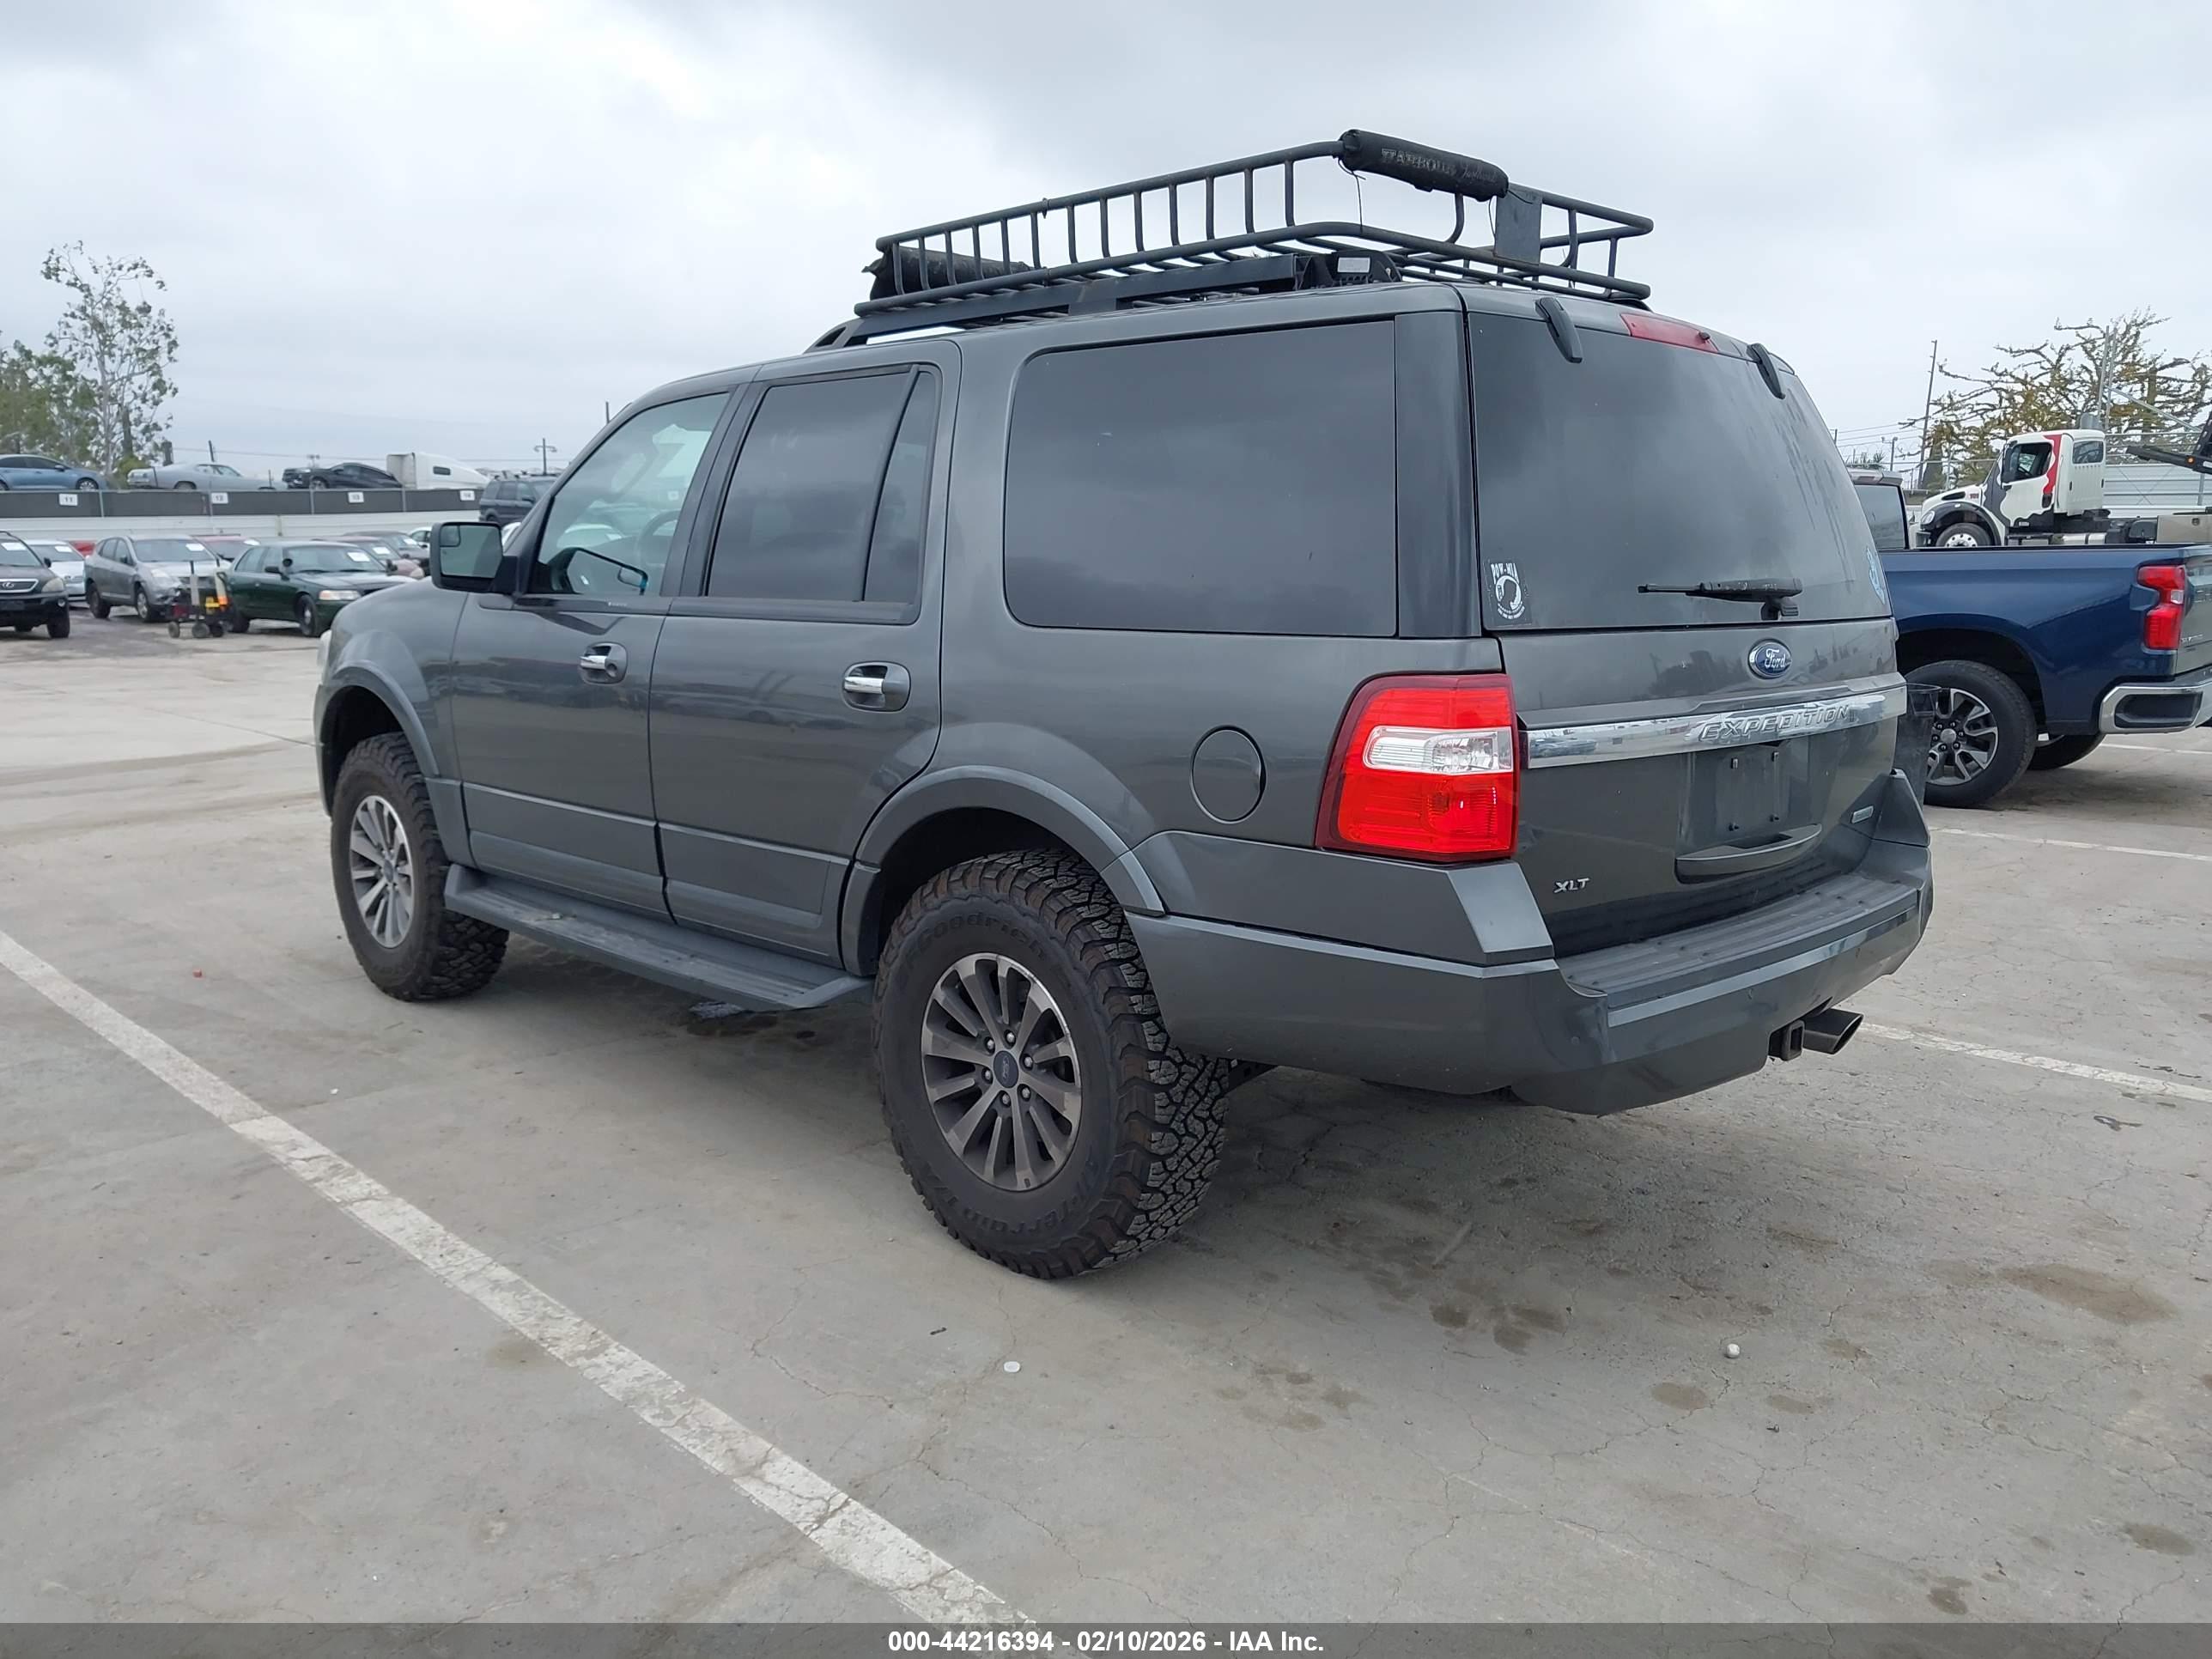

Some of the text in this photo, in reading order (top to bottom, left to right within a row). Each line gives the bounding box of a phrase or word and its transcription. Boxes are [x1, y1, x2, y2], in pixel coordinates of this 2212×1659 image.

[1765, 648, 1786, 668] Ford
[1699, 705, 1850, 742] EXPEDITION
[1554, 878, 1589, 893] XLT
